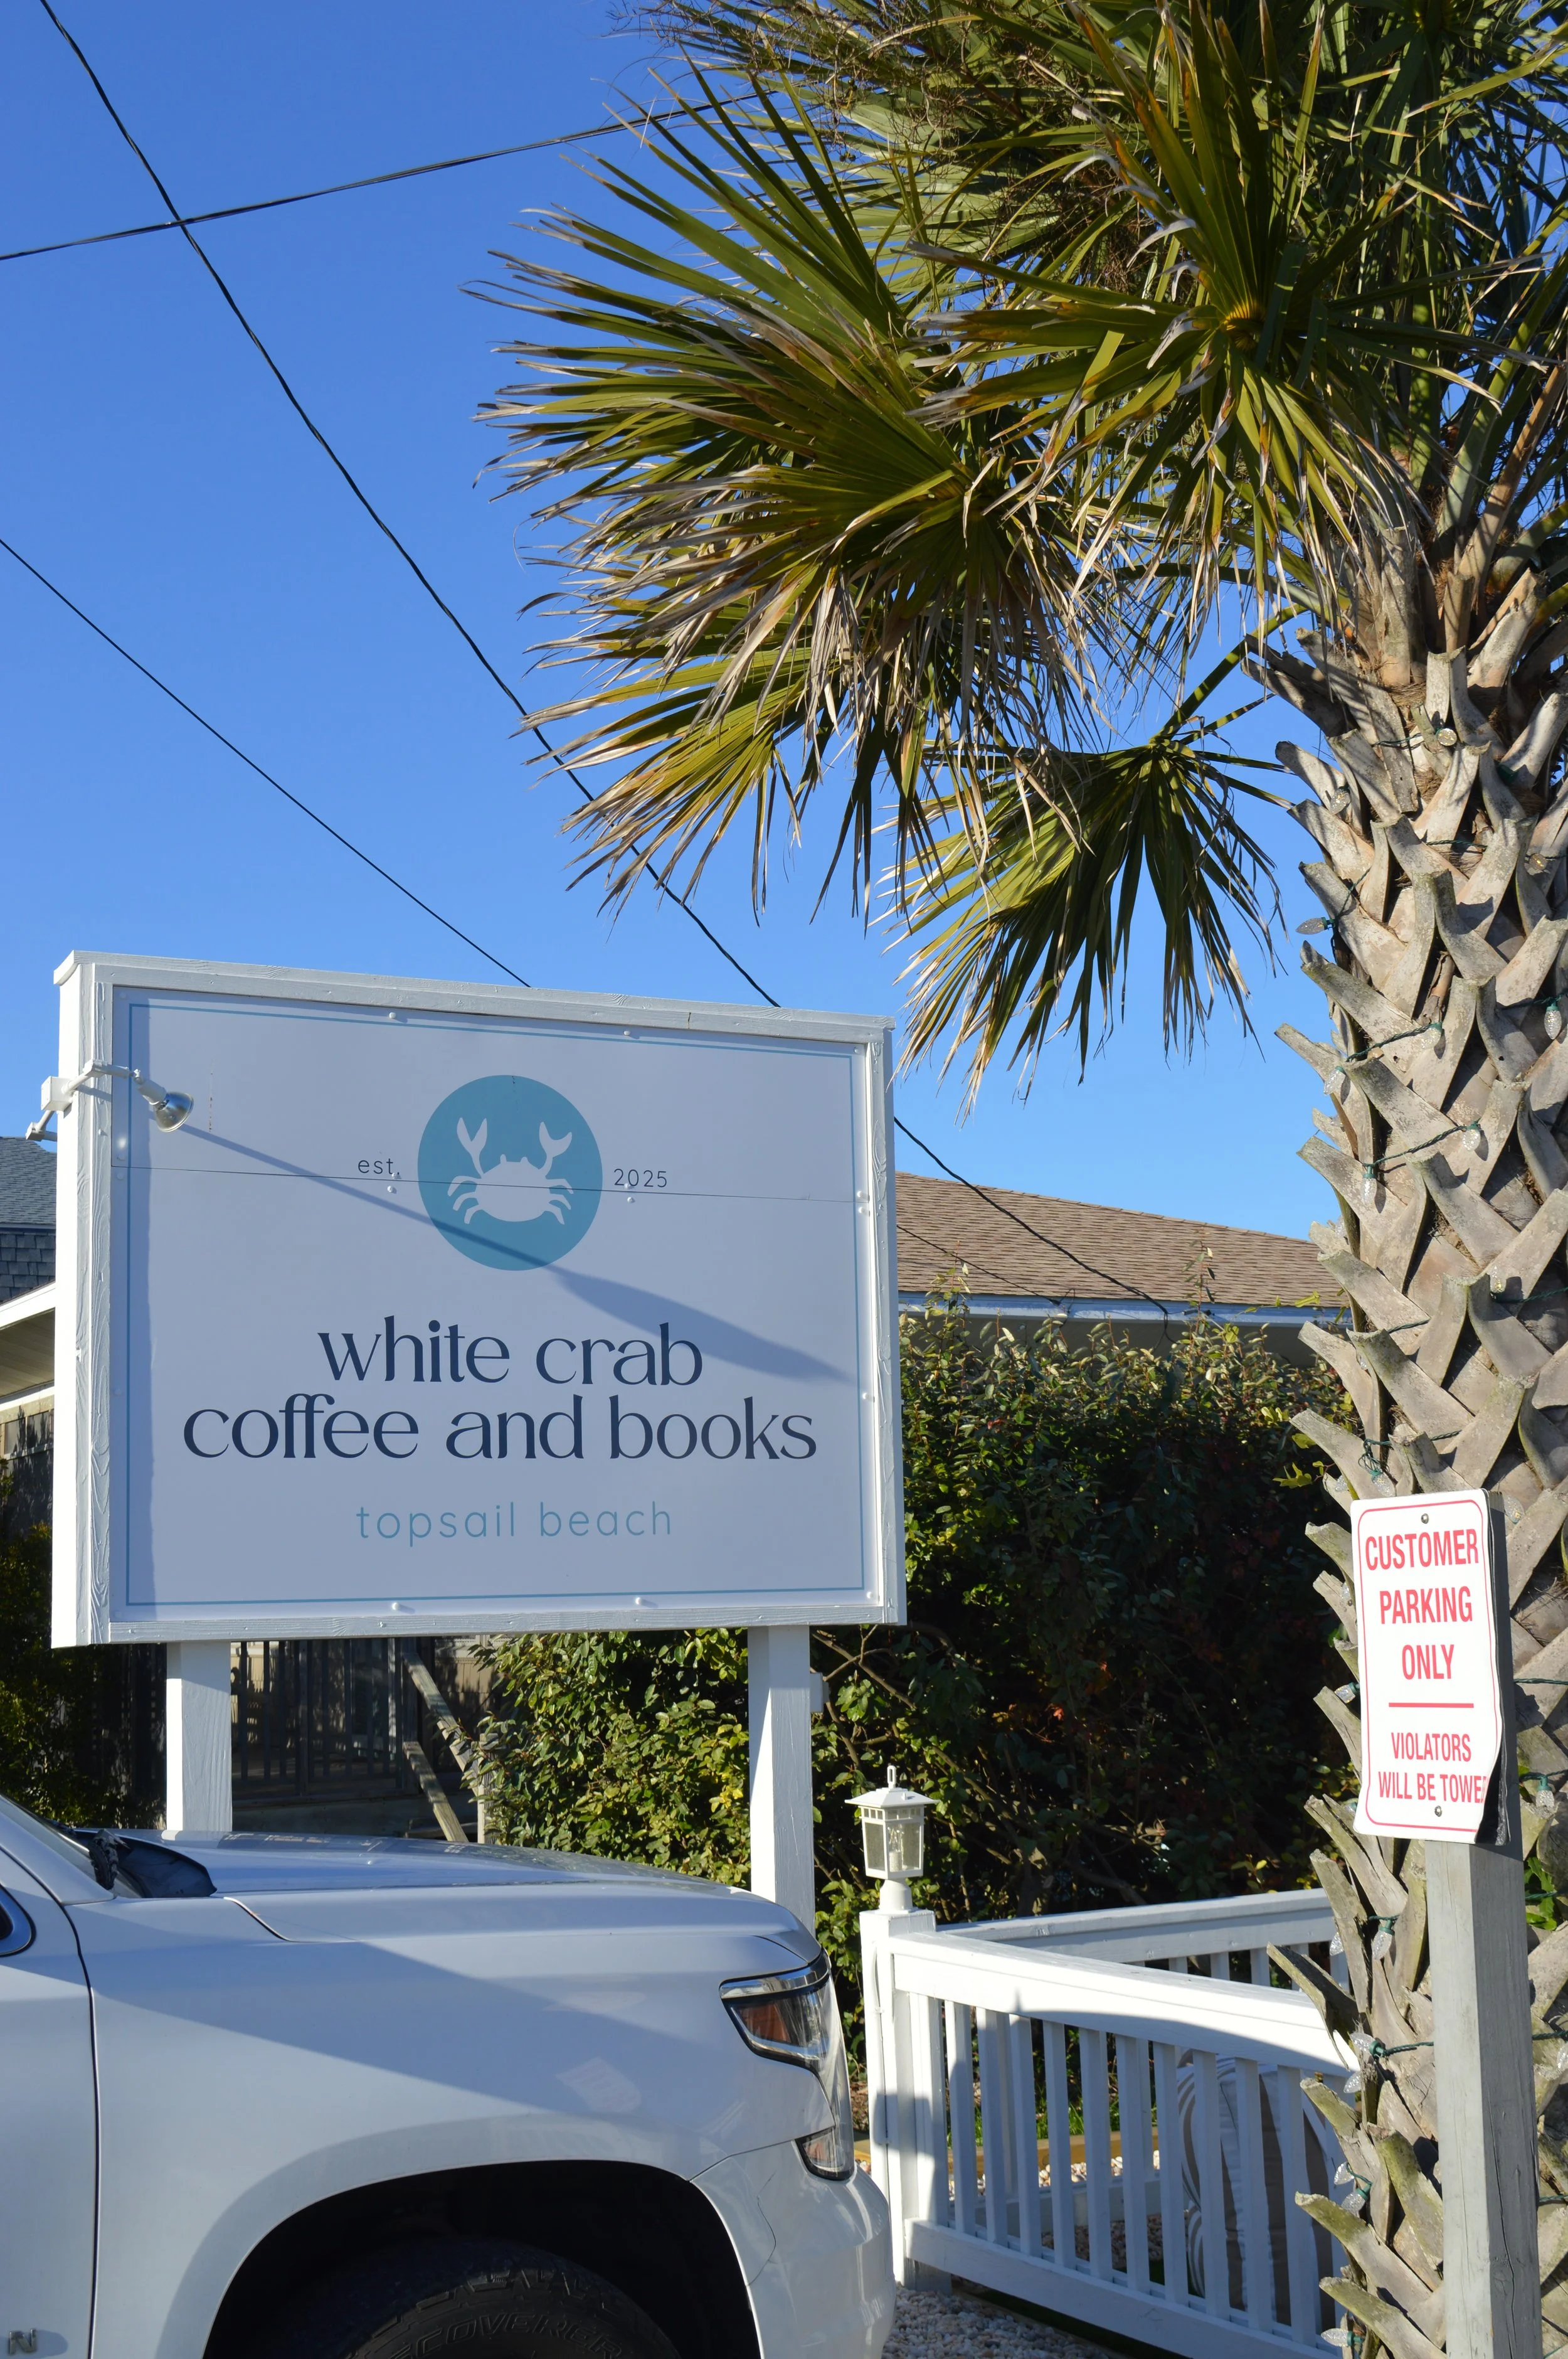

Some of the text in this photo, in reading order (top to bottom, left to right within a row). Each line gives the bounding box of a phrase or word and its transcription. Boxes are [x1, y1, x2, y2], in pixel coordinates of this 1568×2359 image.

[358, 1158, 668, 1188] est. 2025
[317, 1315, 703, 1386] white crab
[183, 1393, 817, 1460] coffee and books
[355, 1501, 672, 1548] topsail beach
[1365, 1528, 1479, 1571] CUSTOMER
[1379, 1585, 1473, 1625] PARKING
[1402, 1644, 1454, 1680] ONLY
[1391, 1732, 1472, 1762] VIOLATORS
[1378, 1771, 1412, 1799] WILL
[1416, 1772, 1436, 1801] BE
